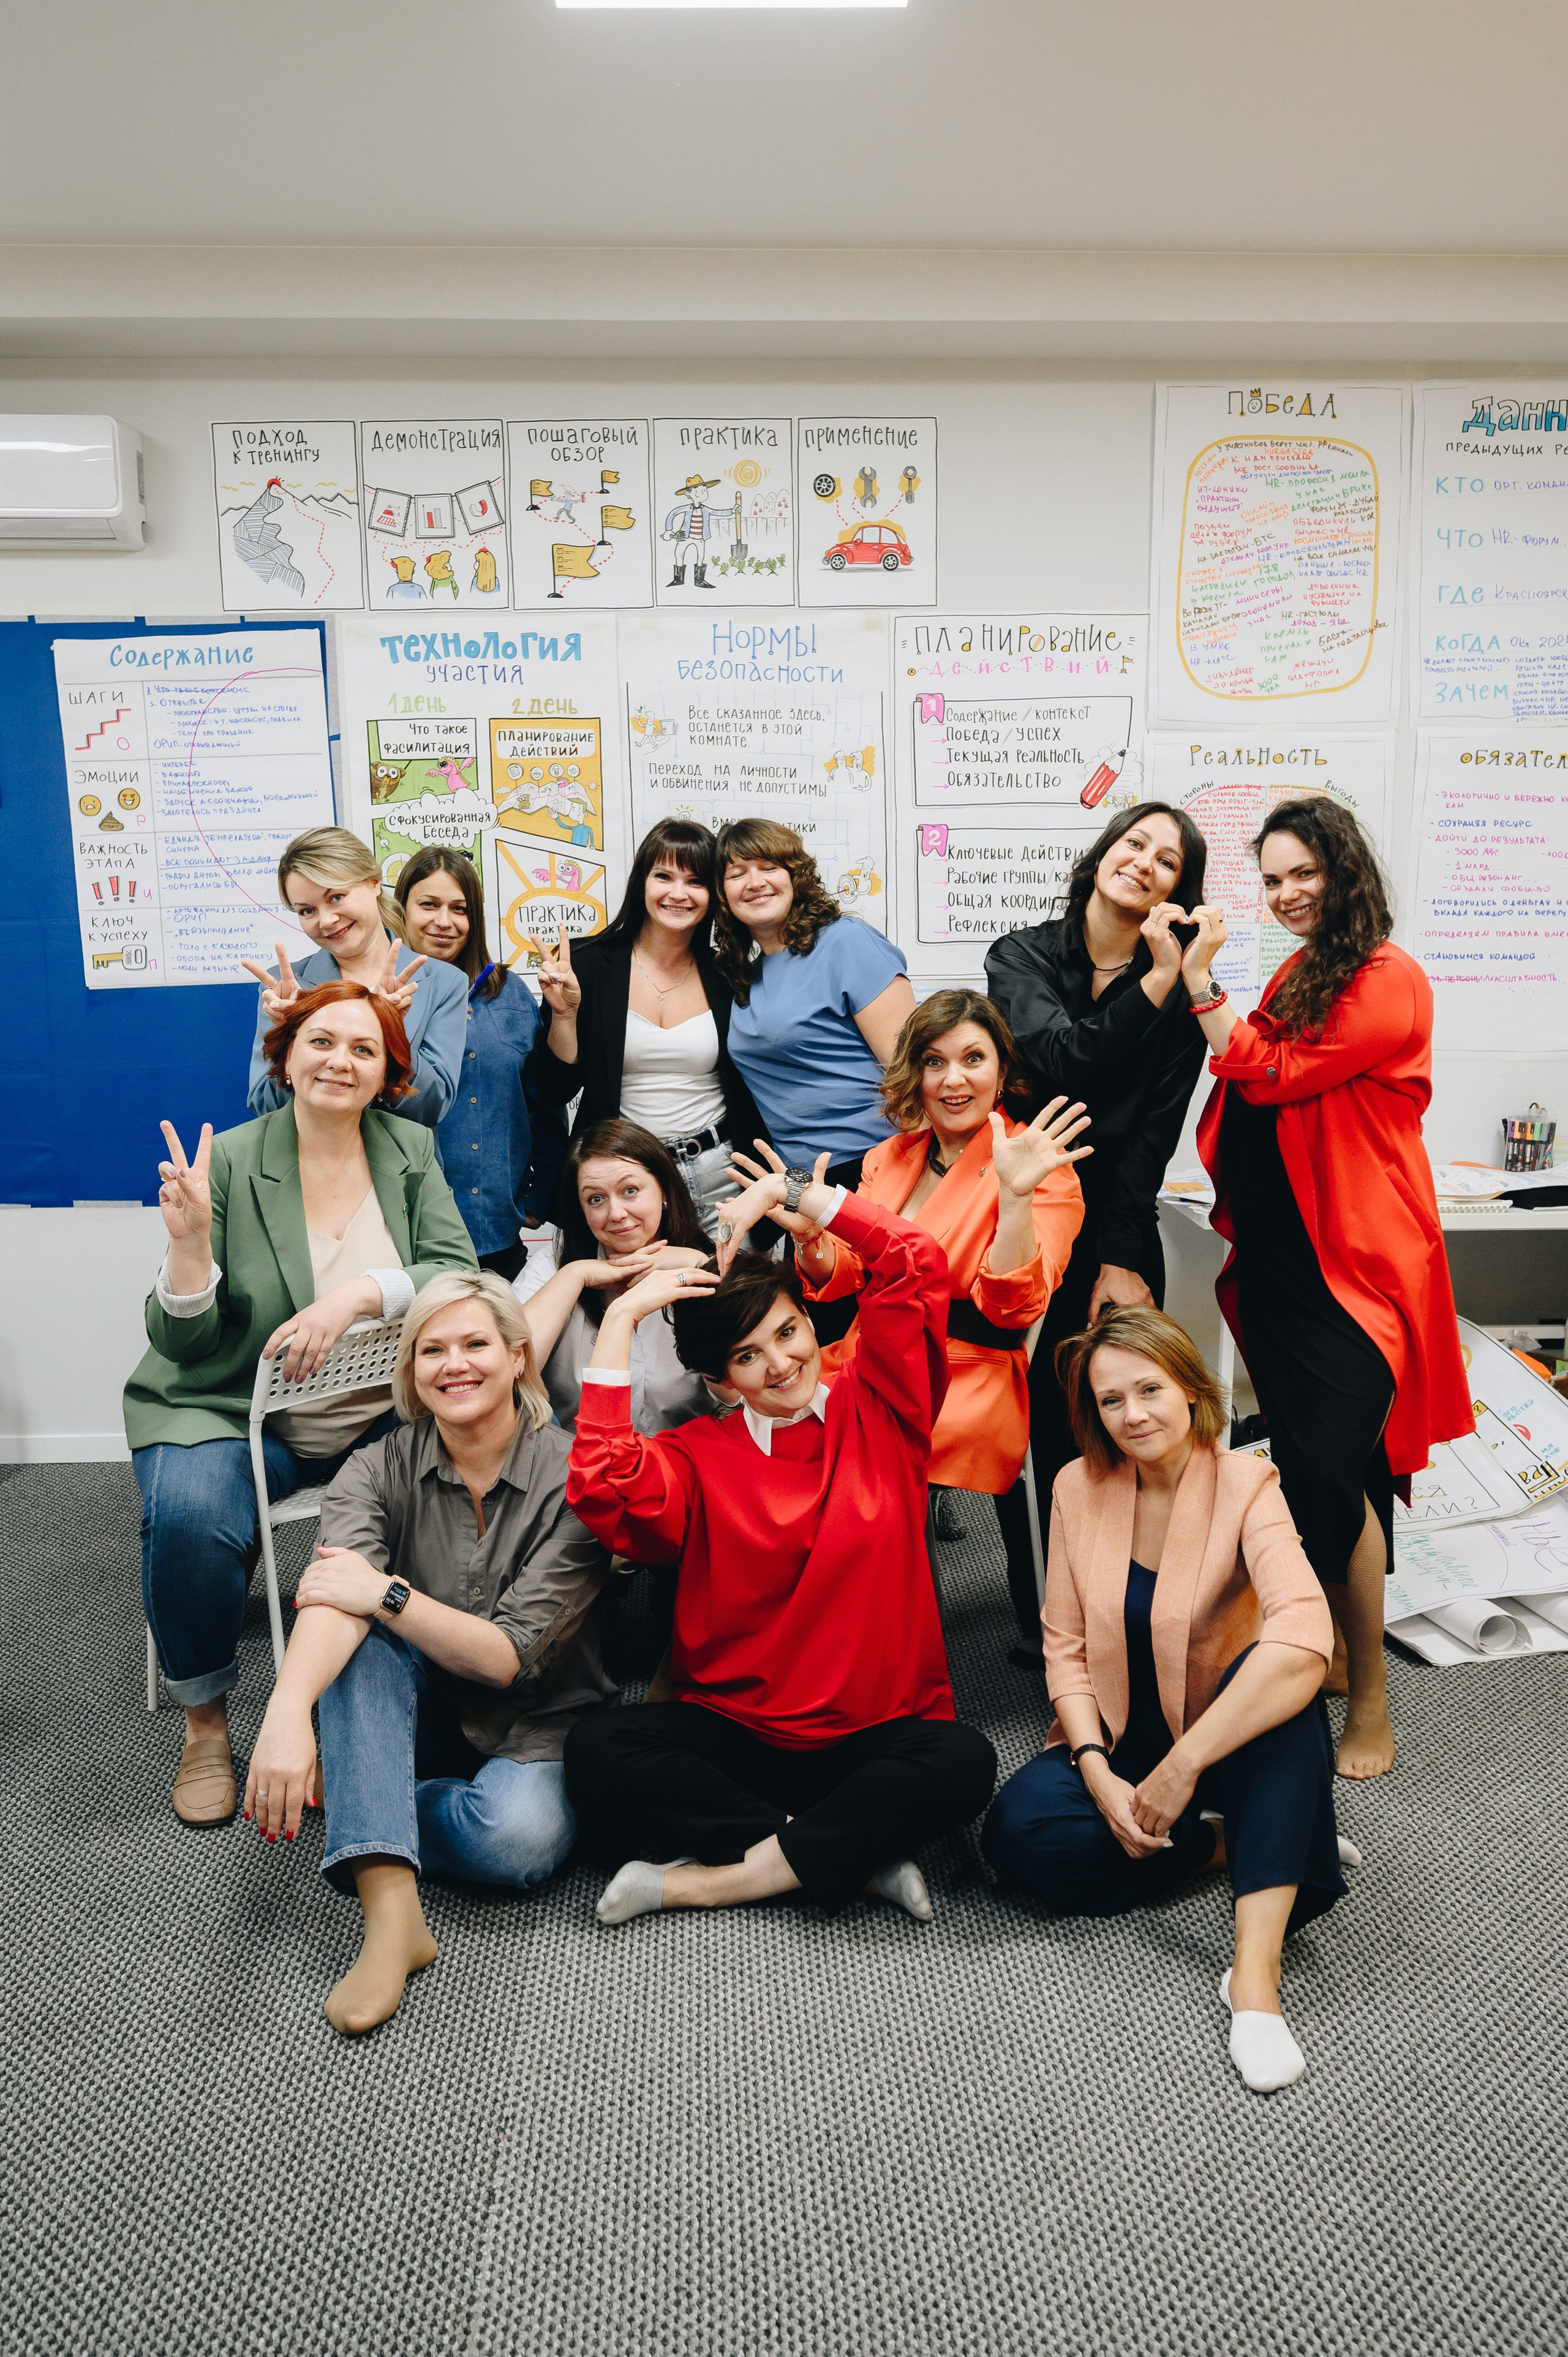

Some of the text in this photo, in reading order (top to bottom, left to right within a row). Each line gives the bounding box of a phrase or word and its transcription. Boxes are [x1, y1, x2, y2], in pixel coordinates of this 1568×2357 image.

[1436, 477, 1483, 494] КТО
[1437, 529, 1483, 549] ЧТО
[69, 691, 123, 704] ШАГИ
[75, 770, 138, 783] ЭМОЦИИ
[80, 842, 147, 855] ВАЖНОСТЬ
[84, 858, 134, 869] ЭТАПА
[92, 916, 132, 928] КЛЮЧ
